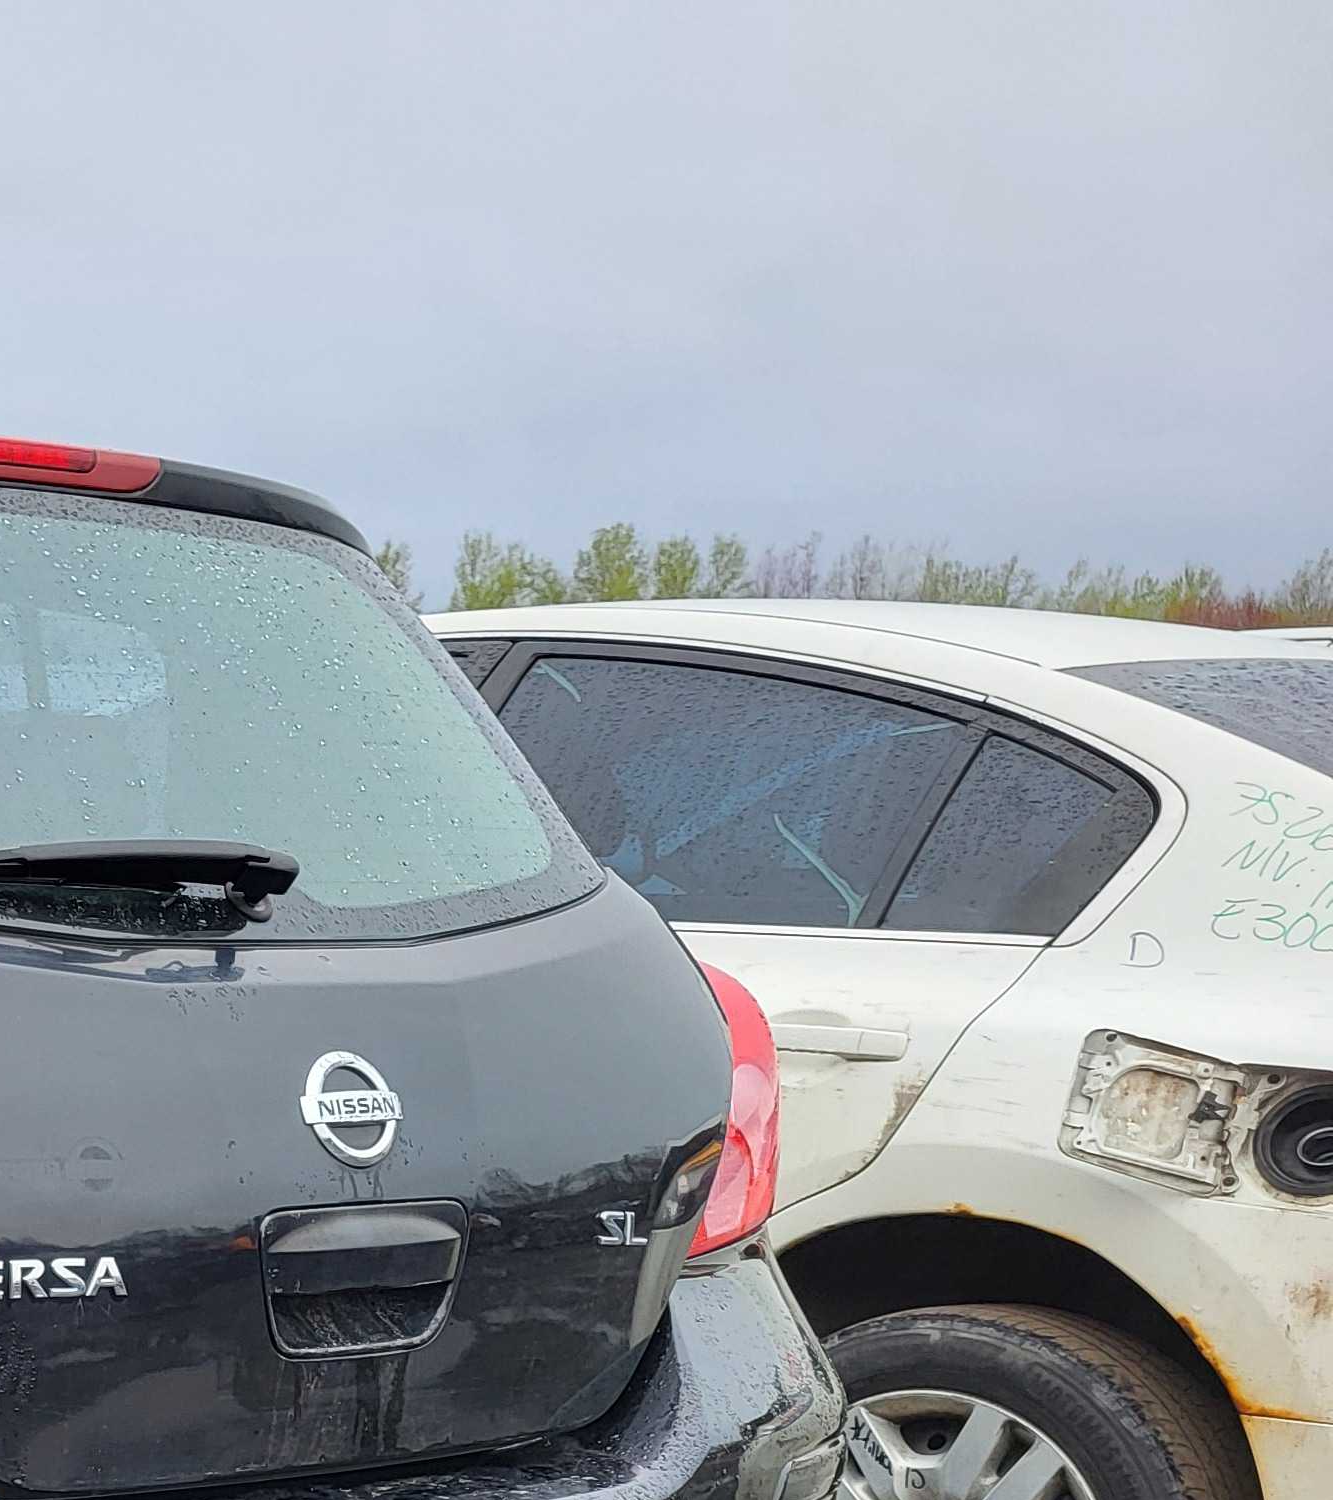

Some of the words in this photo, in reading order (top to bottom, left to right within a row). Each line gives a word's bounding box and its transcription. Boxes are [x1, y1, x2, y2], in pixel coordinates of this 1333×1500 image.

[1120, 932, 1165, 968] D
[317, 1097, 396, 1117] NISSAN
[595, 1211, 648, 1245] SL
